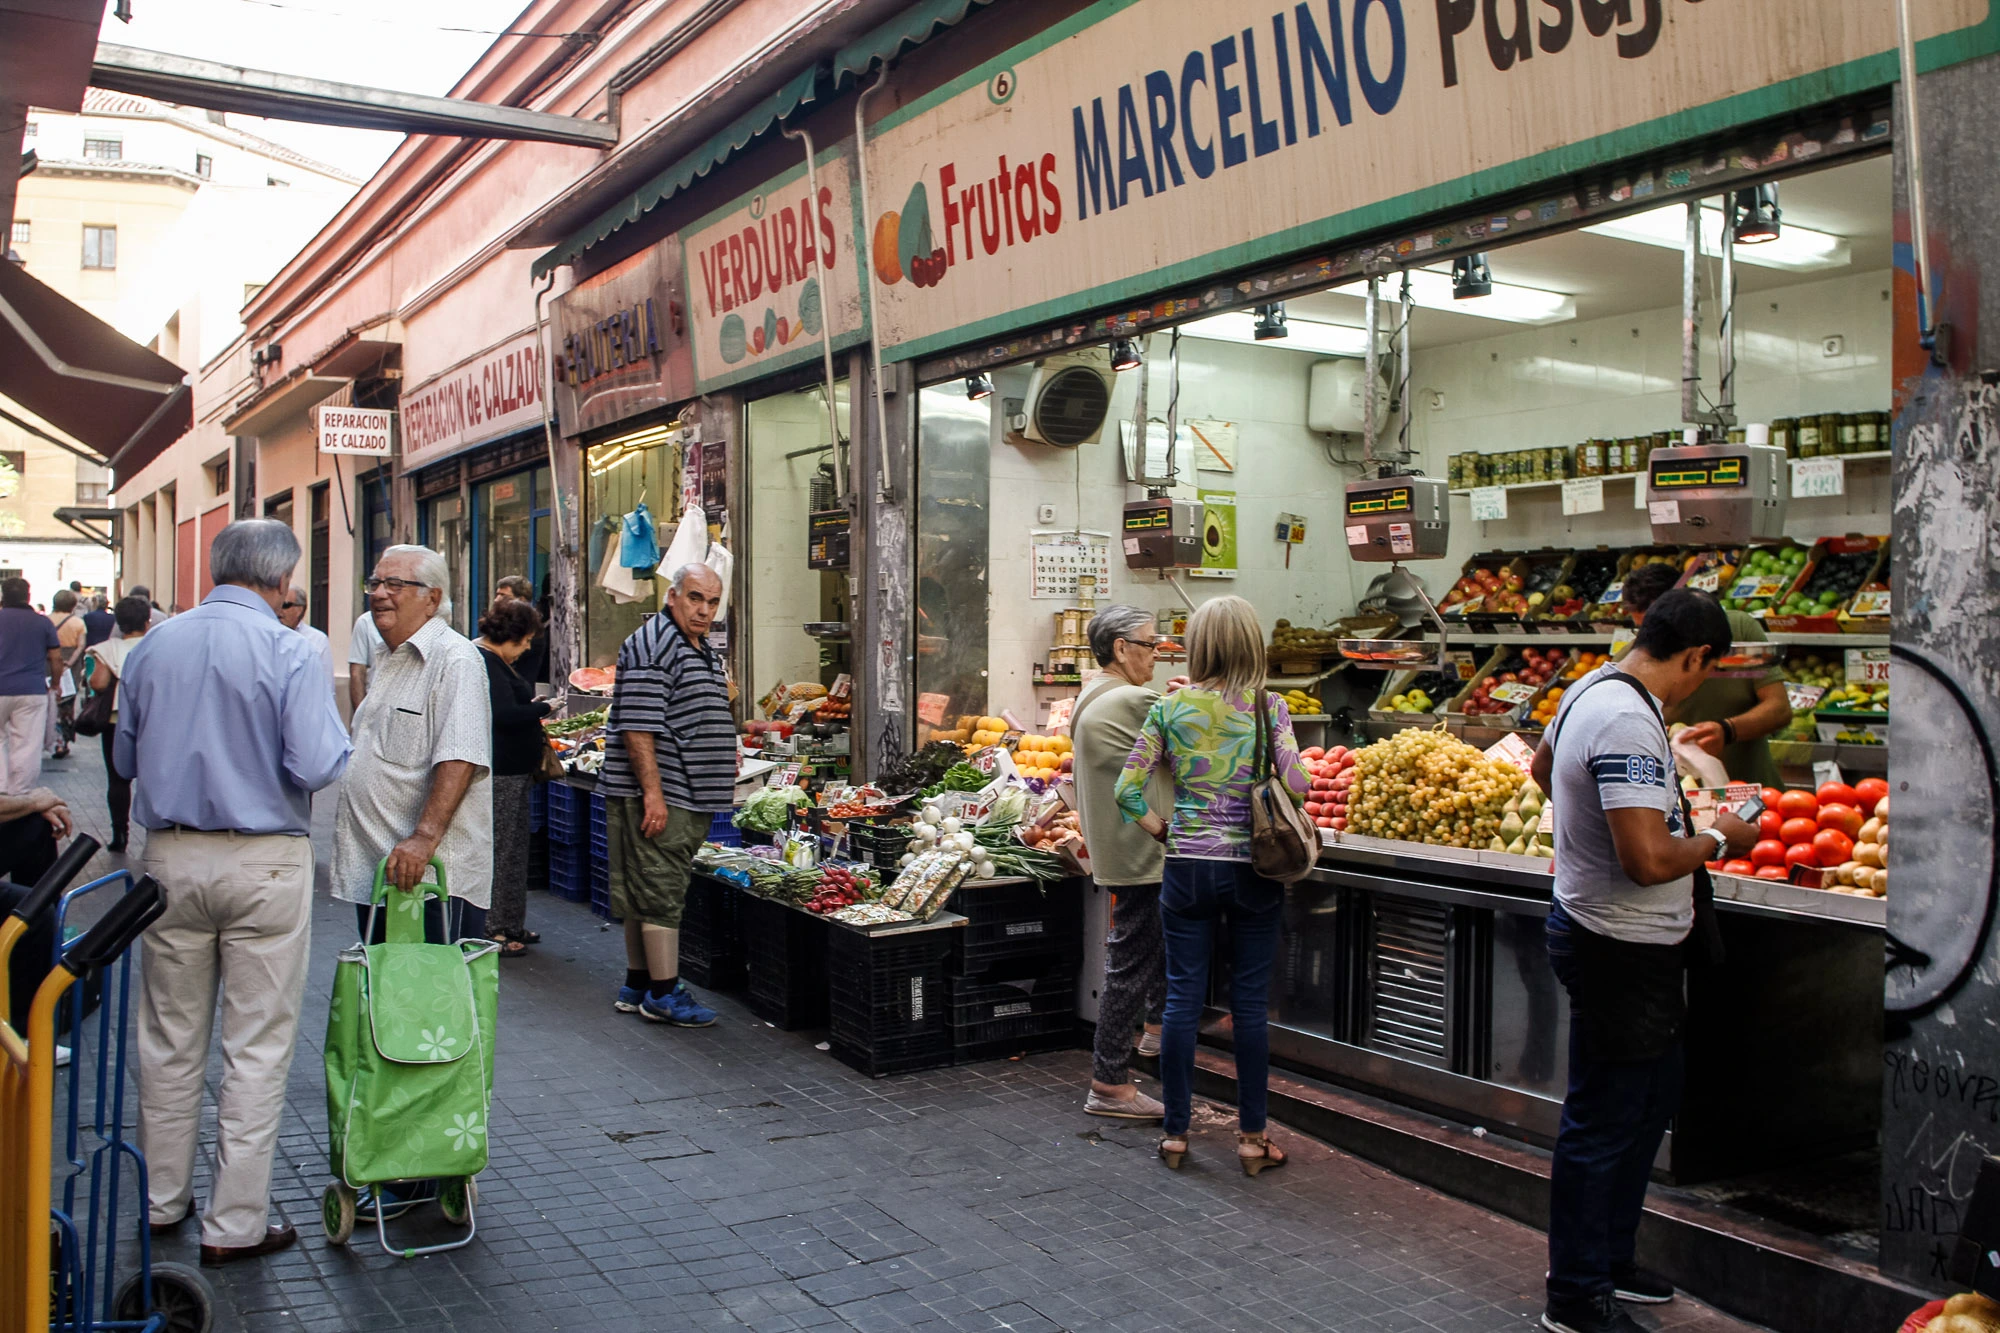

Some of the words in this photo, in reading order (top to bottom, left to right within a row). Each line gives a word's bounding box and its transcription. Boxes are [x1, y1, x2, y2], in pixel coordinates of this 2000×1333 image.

[996, 73, 1009, 97] 6
[938, 152, 1062, 267] Frutas
[1072, 0, 1407, 222] MARCELINO
[753, 196, 761, 215] 7
[699, 186, 836, 318] VERDURAS
[563, 298, 664, 388] FRUTERIA
[404, 378, 466, 455] REPARACION
[467, 373, 482, 427] de
[483, 344, 546, 421] CALZADO
[324, 412, 388, 430] REPARACION
[325, 432, 338, 448] DE
[341, 433, 386, 450] CALZADO
[1867, 663, 1875, 679] 3
[1626, 754, 1657, 785] 89
